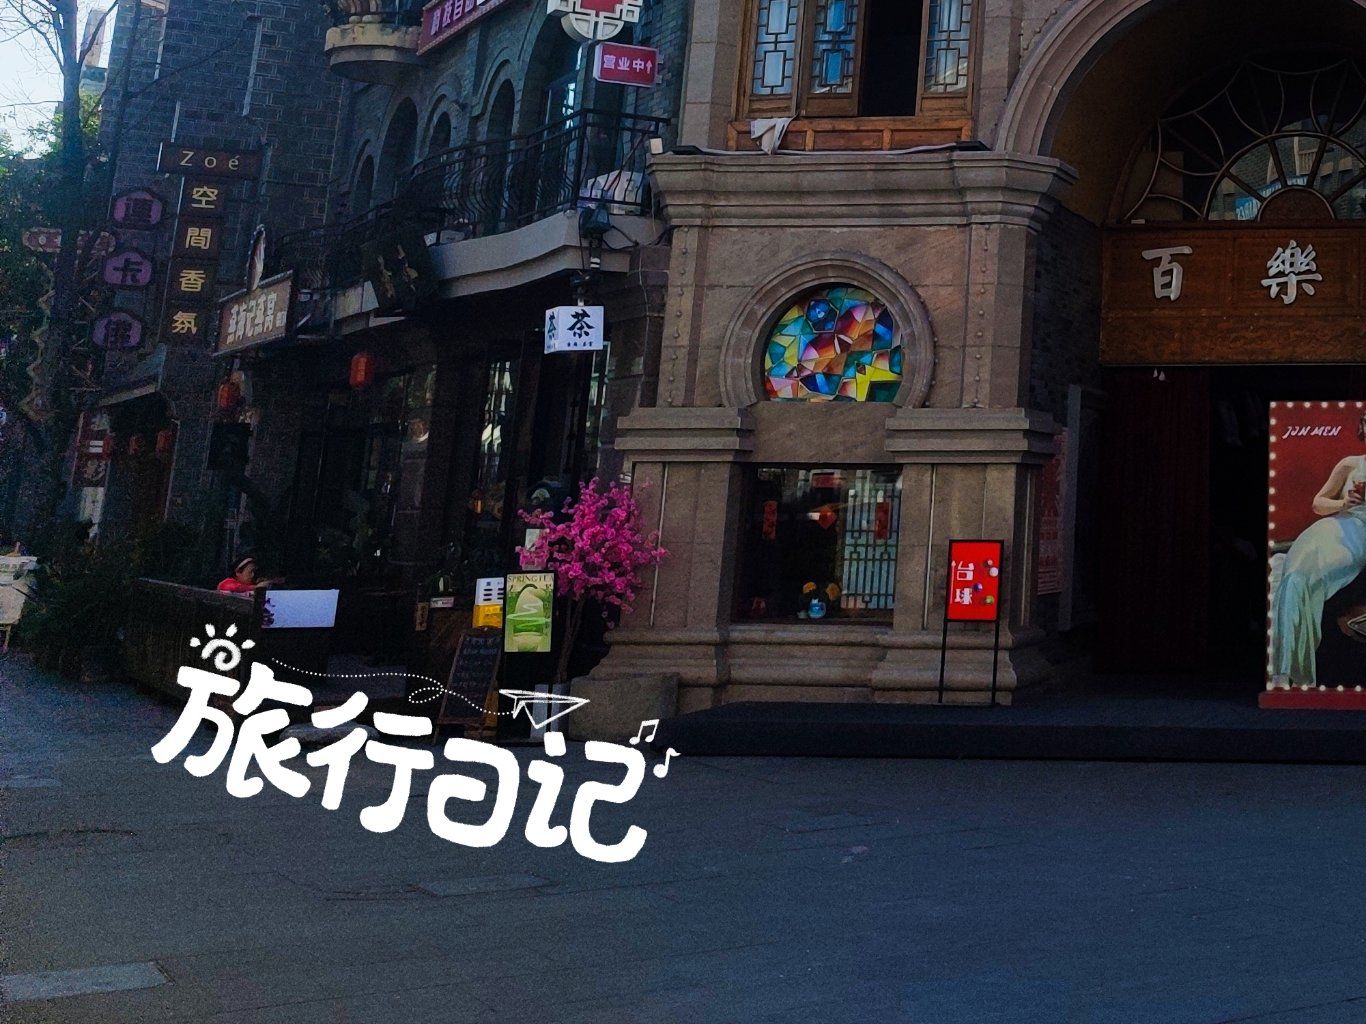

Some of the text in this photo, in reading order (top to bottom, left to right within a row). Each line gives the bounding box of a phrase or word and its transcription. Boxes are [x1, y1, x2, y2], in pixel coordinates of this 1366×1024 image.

[603, 54, 645, 73] 营业中
[179, 149, 240, 170] Zoé
[171, 185, 219, 335] 空間香氛
[566, 308, 595, 339] 茶
[1310, 426, 1342, 436] MEN
